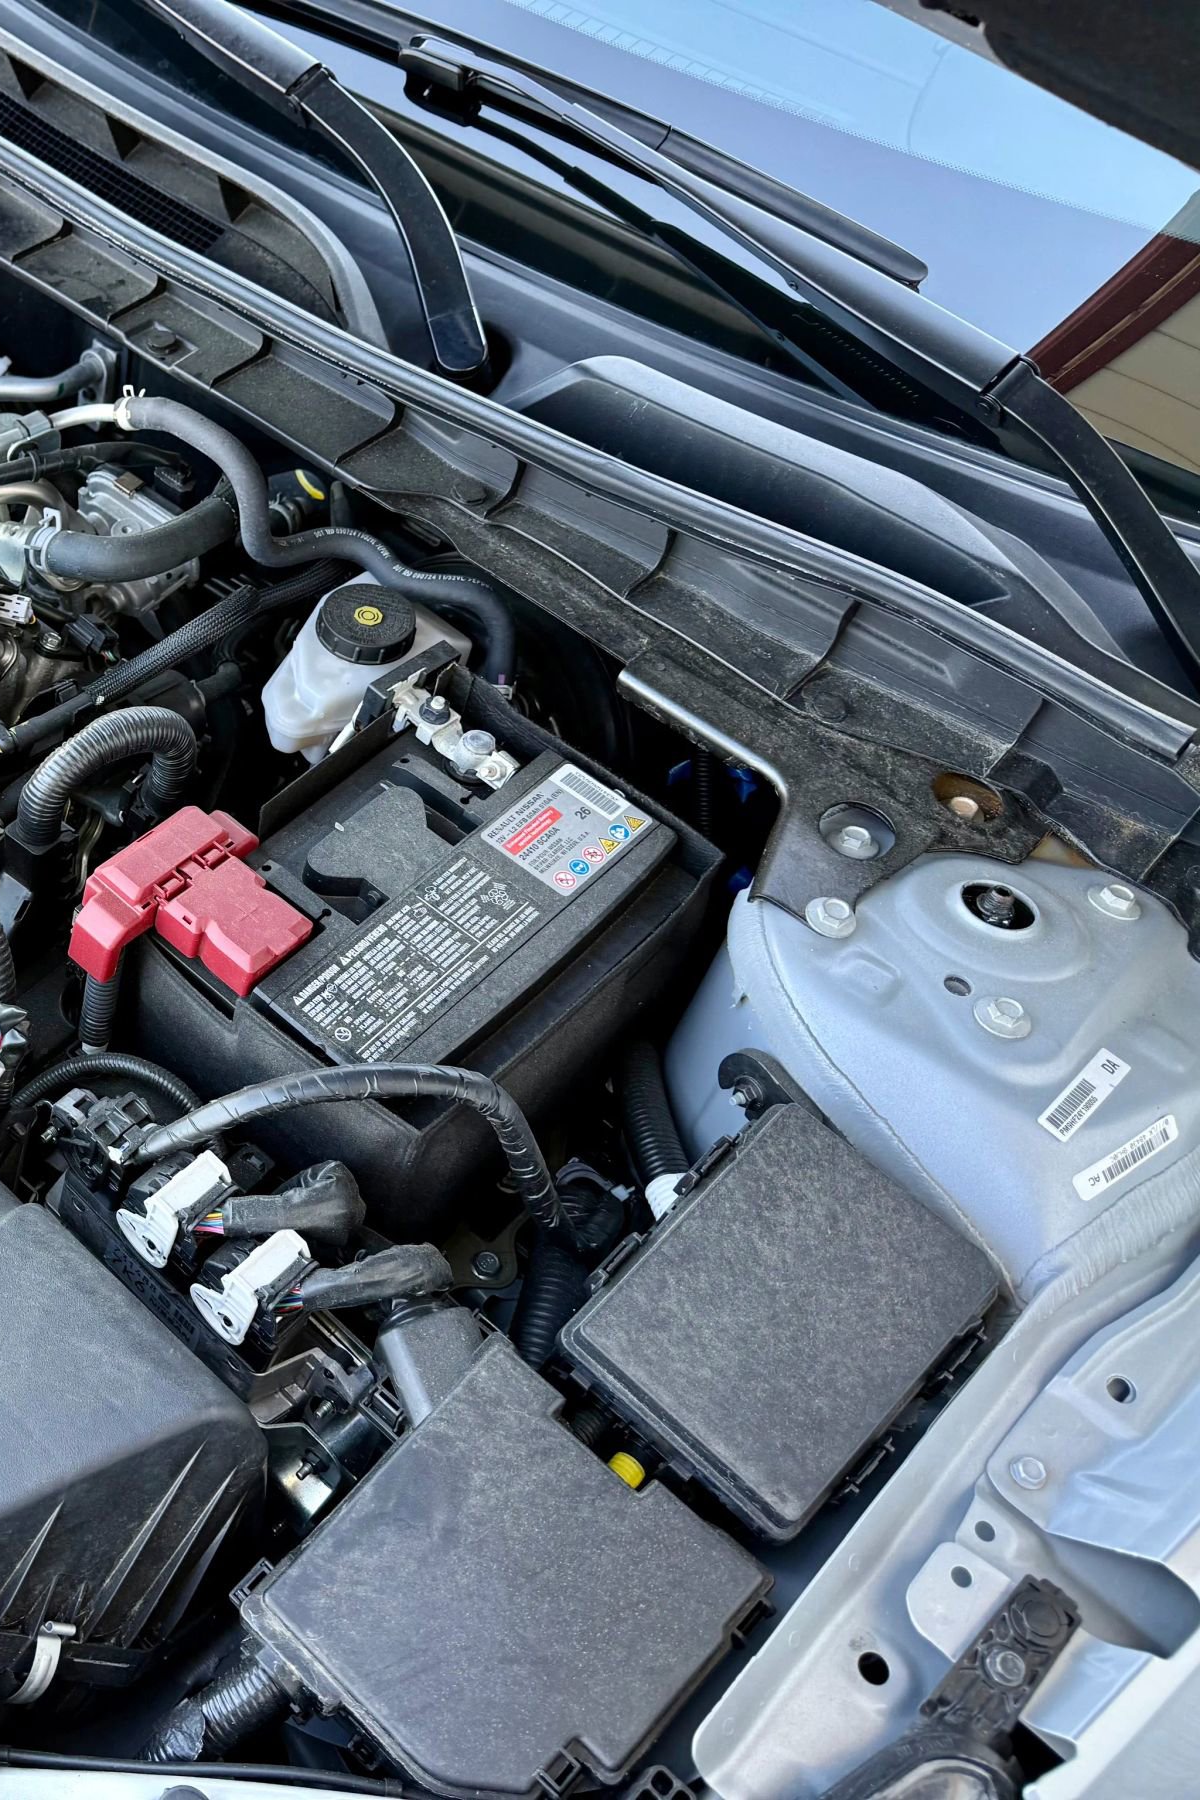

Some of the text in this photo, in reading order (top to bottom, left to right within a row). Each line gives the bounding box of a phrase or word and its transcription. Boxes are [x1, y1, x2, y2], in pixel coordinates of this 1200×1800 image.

[487, 792, 543, 838] RENAULT NISSAN
[574, 806, 591, 819] 26
[518, 843, 539, 860] 24410
[298, 963, 340, 998] DANGER/POISON
[1101, 1057, 1119, 1074] DA
[1087, 1173, 1101, 1186] AC
